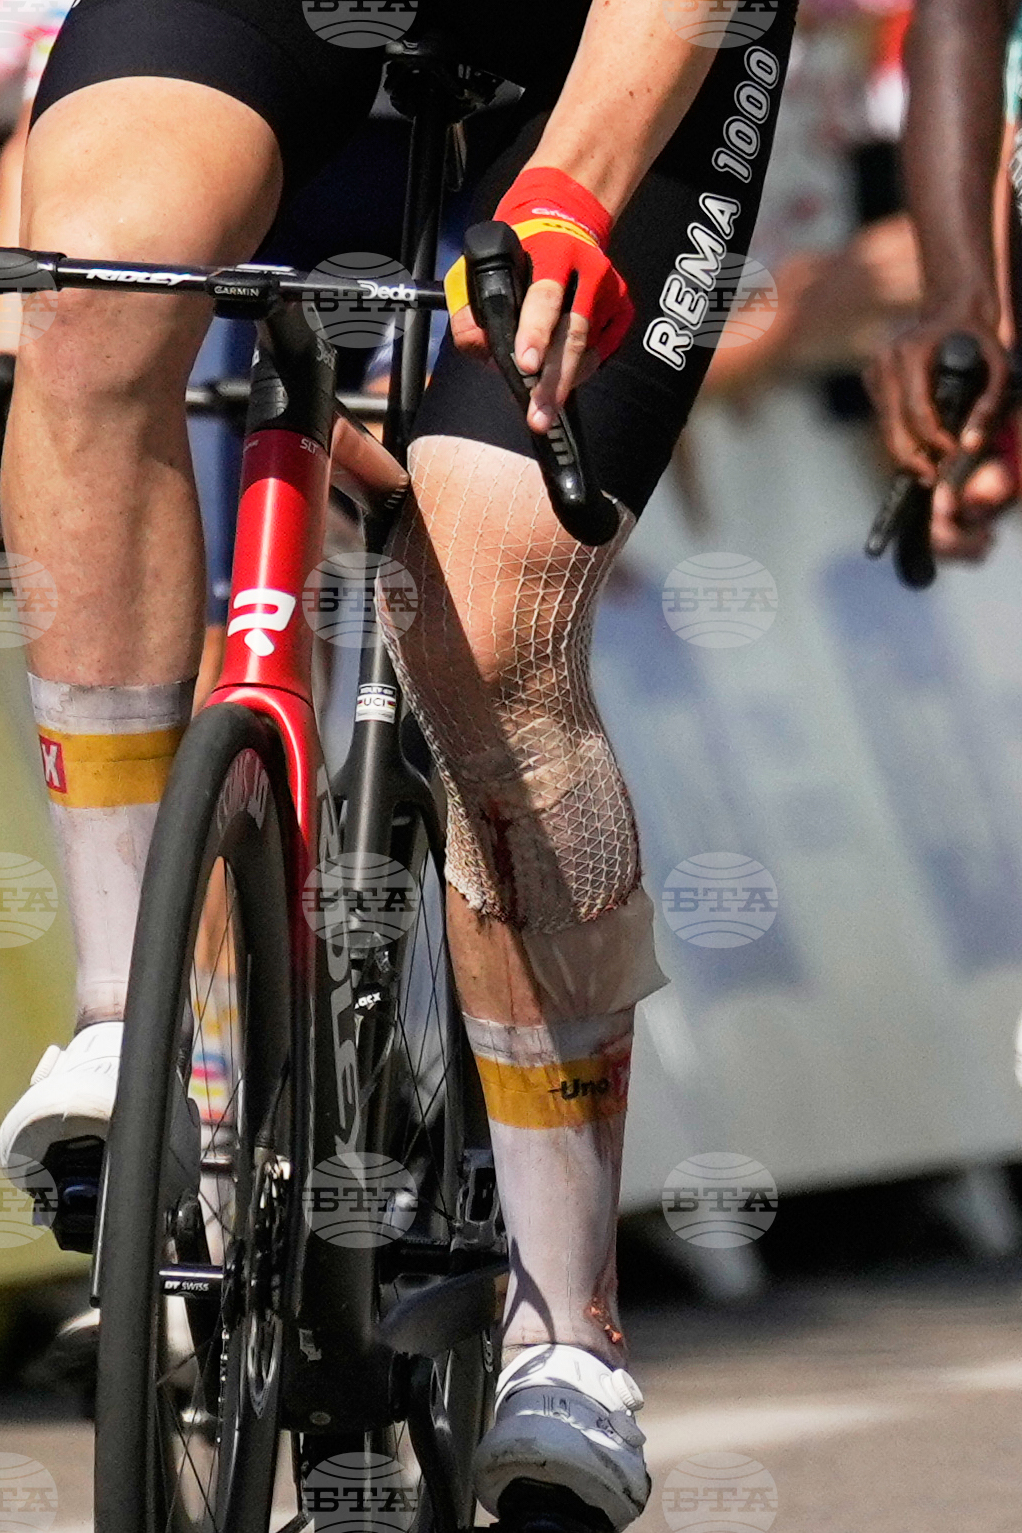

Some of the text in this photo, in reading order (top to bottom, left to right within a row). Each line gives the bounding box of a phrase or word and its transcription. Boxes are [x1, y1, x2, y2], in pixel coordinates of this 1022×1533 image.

[643, 45, 779, 371] REMA 1000
[86, 268, 191, 286] RIDLEY
[214, 285, 260, 297] GARMIN
[357, 279, 417, 301] Deda
[363, 697, 386, 708] UCI
[163, 1280, 210, 1291] DT SWISS
